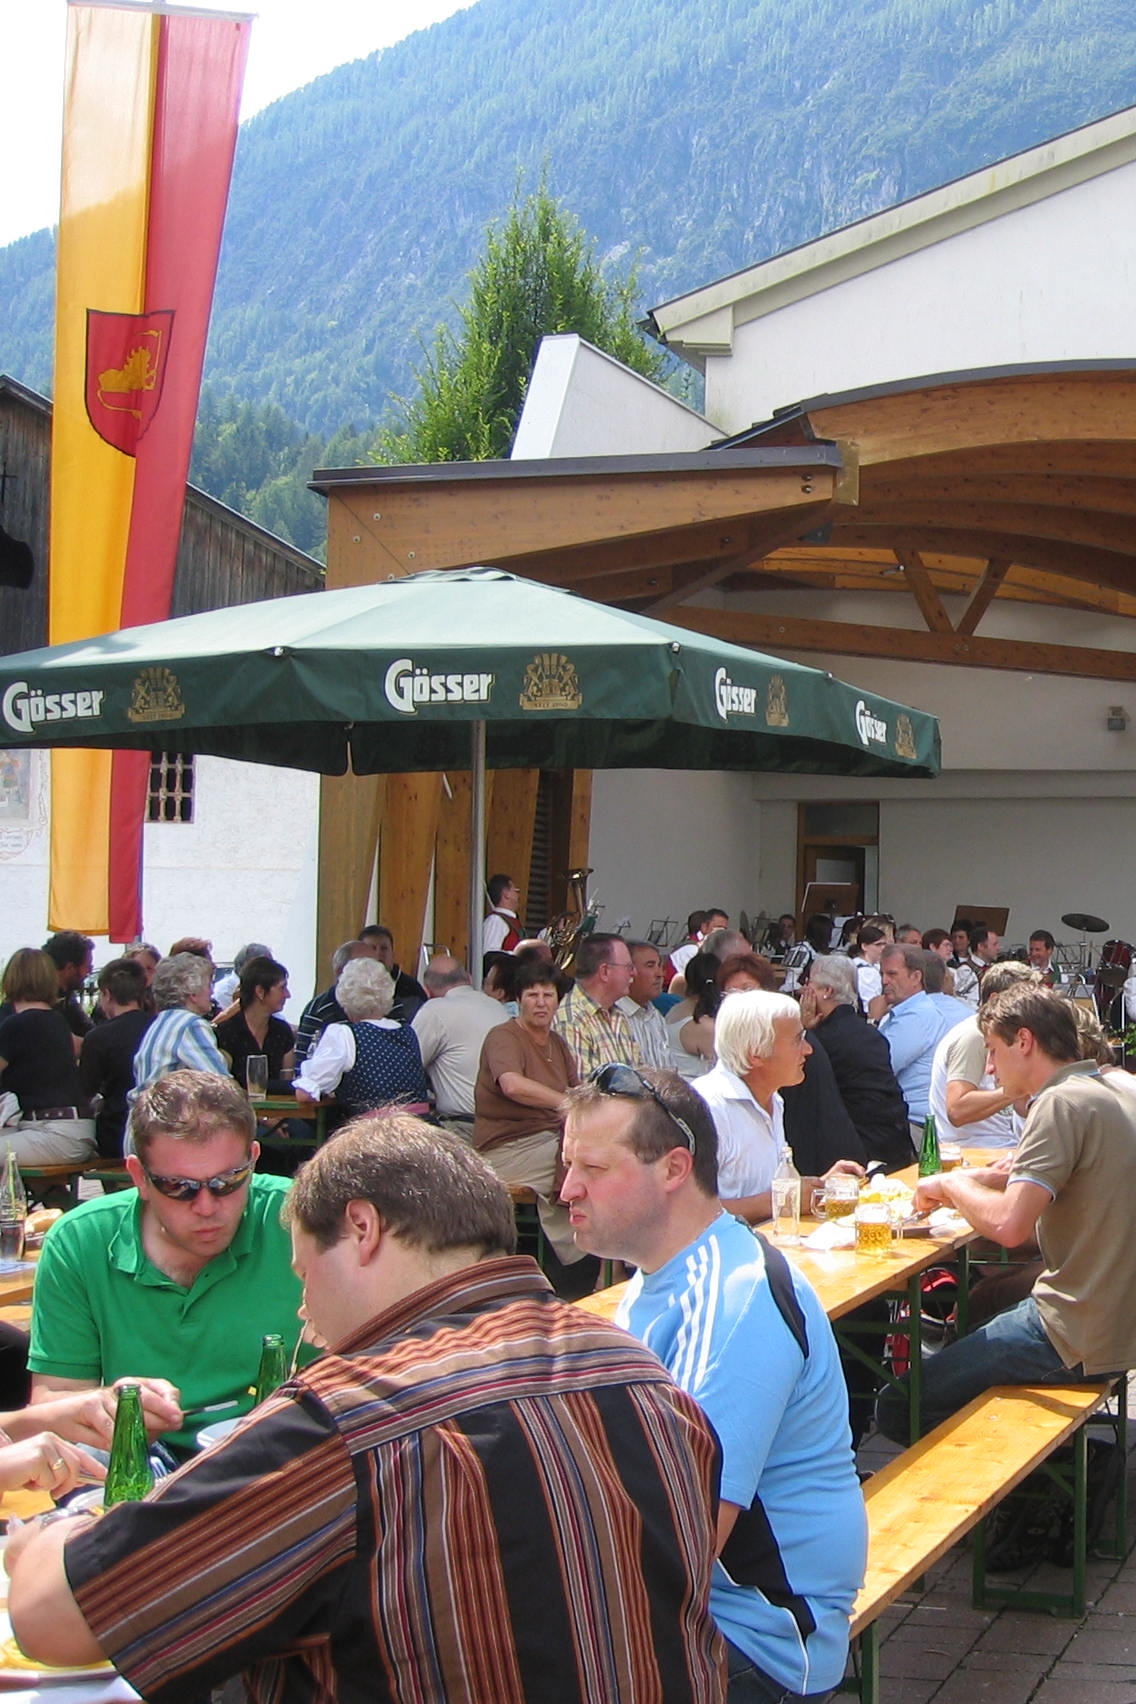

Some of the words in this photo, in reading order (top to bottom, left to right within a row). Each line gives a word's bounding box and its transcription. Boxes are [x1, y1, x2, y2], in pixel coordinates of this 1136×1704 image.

[2, 682, 104, 733] Gösser
[384, 659, 493, 713] Gösser
[715, 666, 758, 719] Gösser
